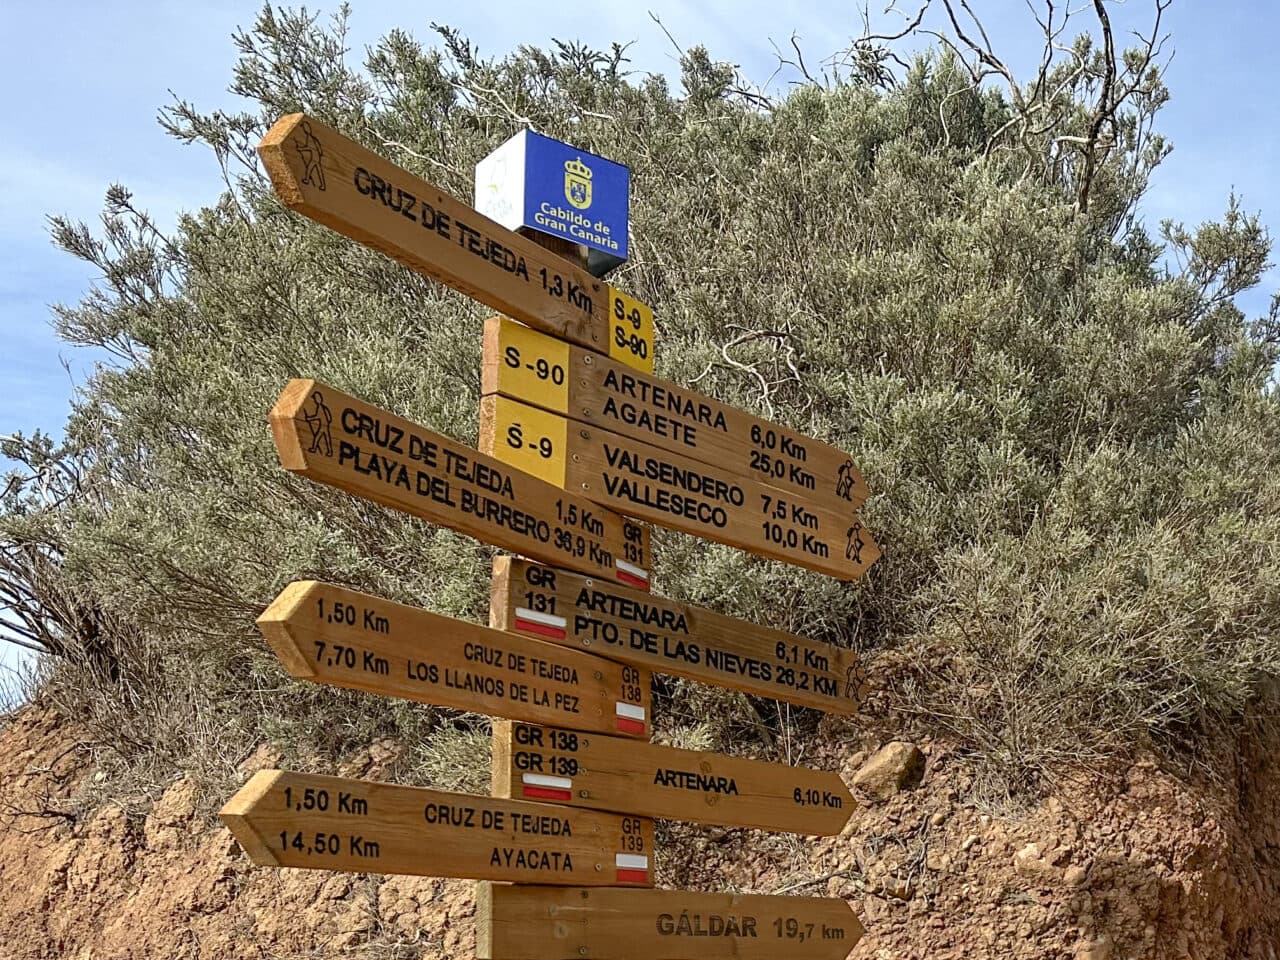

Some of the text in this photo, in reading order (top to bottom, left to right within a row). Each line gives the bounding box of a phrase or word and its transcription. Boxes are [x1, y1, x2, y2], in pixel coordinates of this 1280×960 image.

[534, 213, 618, 251] Gran Canaria
[540, 202, 610, 235] Cabildo de
[353, 167, 417, 222] CRUZ
[422, 203, 450, 240] DE
[456, 221, 529, 282] TEJEDA
[540, 267, 564, 295] 1,3
[567, 284, 593, 314] Km
[603, 369, 807, 462] ARTENARA 6,0 Km
[603, 398, 816, 491] AGAETE 25,0 Km
[341, 407, 604, 537] CRUZ DE TEJEDA 1,5 Km
[602, 444, 819, 531] VALSENDERO 7,5 Km
[339, 443, 411, 492] PLAYA
[416, 471, 456, 507] DEL
[461, 488, 550, 543] BURRERO
[589, 541, 612, 569] Km
[602, 473, 829, 559] VALLESECO 10,0 Km
[623, 523, 643, 543] GR
[623, 542, 644, 565] 131
[525, 565, 557, 591] GR
[525, 591, 556, 614] 131
[316, 599, 580, 685] 1,50 Km CRUZ DE TEJEDA
[575, 587, 829, 672] ARTENARA 6,1 Km
[314, 641, 580, 713] 7,70 Km LOS LLANOS DE LA PEZ
[574, 617, 624, 646] PTO.
[630, 630, 660, 654] DE
[663, 637, 700, 664] LAS
[705, 651, 773, 683] NIEVES
[813, 675, 838, 698] KM
[621, 665, 641, 685] GR
[621, 684, 641, 702] 138
[515, 725, 579, 752] GR 138
[514, 751, 578, 777] GR 139
[654, 768, 842, 809] ARTENARA 6,10 Km
[283, 787, 571, 838] 1,50 Km CRUZ DE TEJEDA
[622, 818, 641, 835] GR
[279, 831, 572, 872] 14,50 Km AYACATA
[622, 836, 643, 851] 139
[656, 909, 844, 943] GÁLDAR 19,7 km
